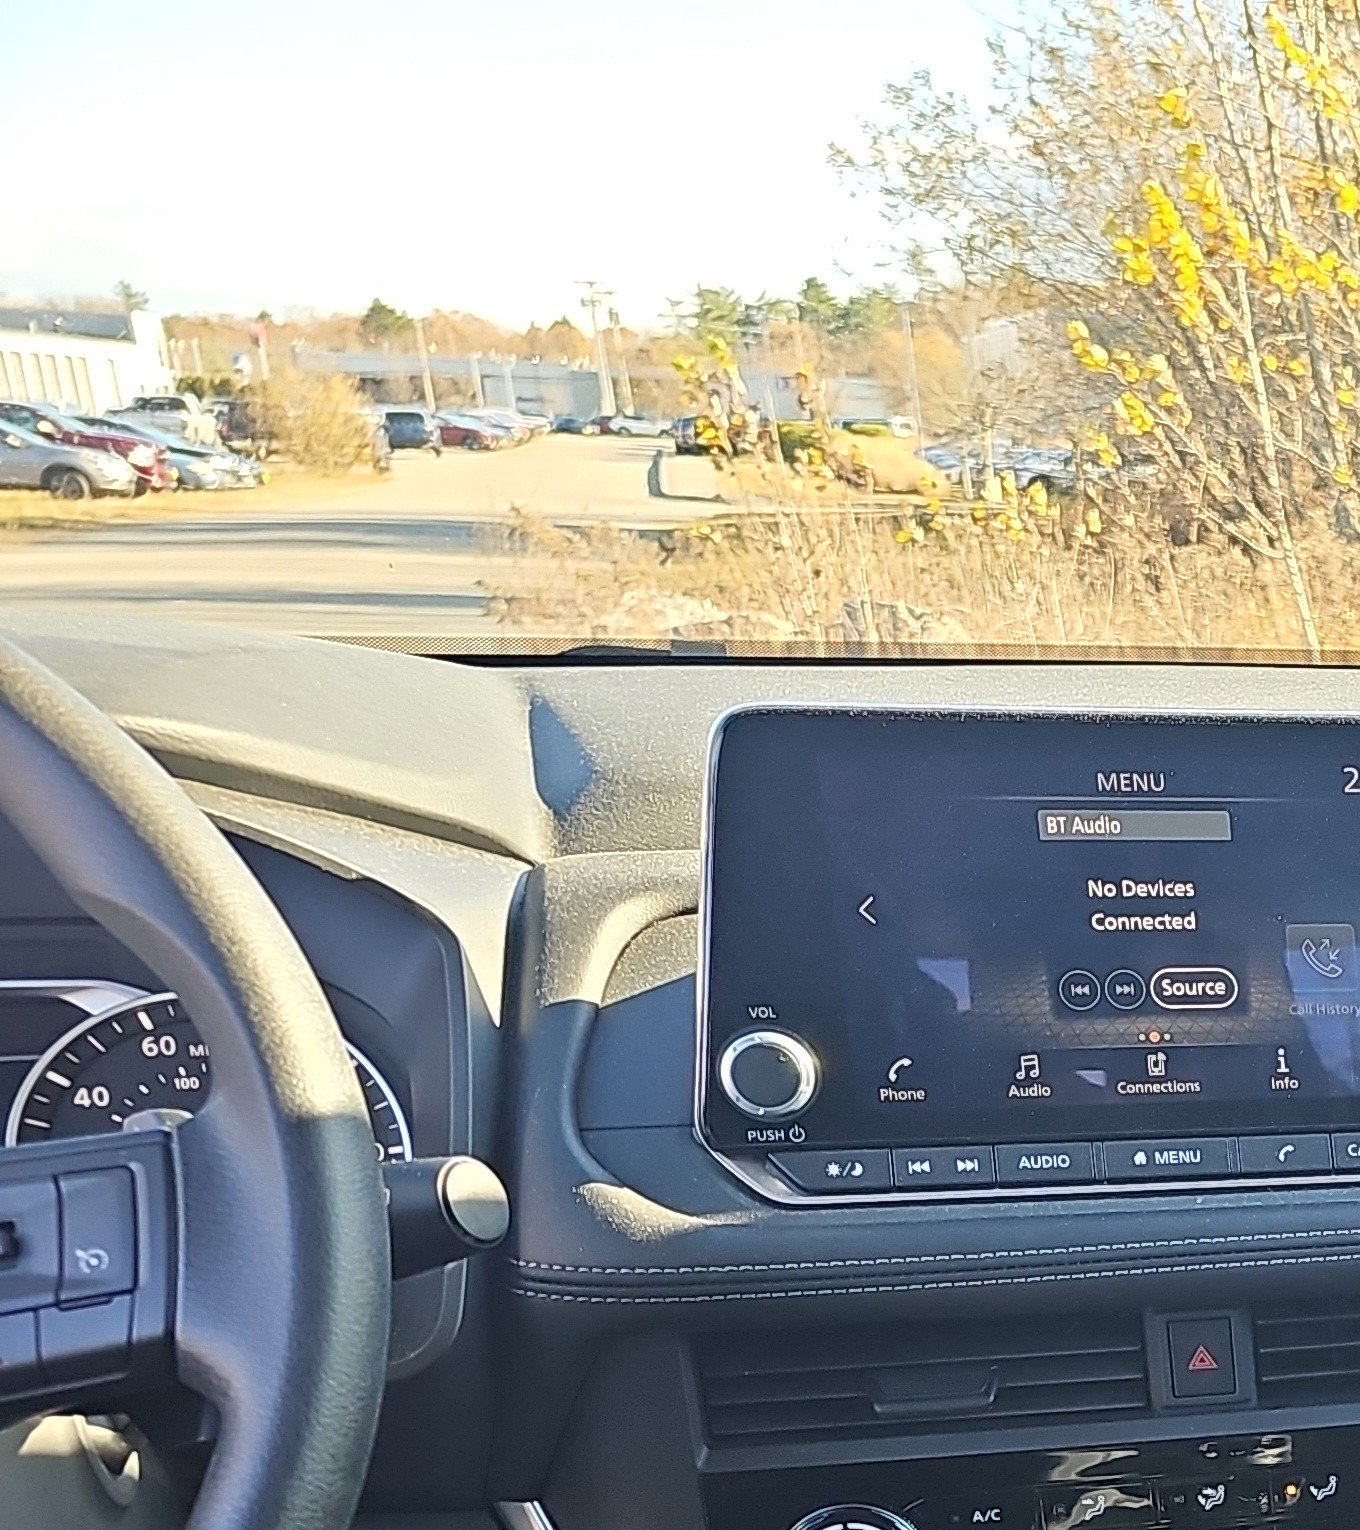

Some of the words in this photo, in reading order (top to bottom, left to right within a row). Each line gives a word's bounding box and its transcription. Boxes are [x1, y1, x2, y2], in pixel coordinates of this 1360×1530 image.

[1097, 773, 1164, 792] MENU
[1046, 817, 1066, 834] BT
[1072, 815, 1121, 835] Audio
[1087, 880, 1116, 898] No
[1121, 879, 1195, 898] Devices
[1091, 913, 1196, 931] Connected
[1161, 978, 1226, 997] Source
[749, 1006, 776, 1019] VOL
[1289, 1002, 1311, 1016] Call
[141, 1036, 177, 1057] 60
[174, 1077, 200, 1090] 100
[1008, 1083, 1051, 1098] Audio
[1117, 1080, 1201, 1094] Connections
[1271, 1076, 1299, 1090] Info
[74, 1085, 110, 1107] 40
[880, 1086, 926, 1102] Phone
[747, 1129, 785, 1143] PUSH
[1018, 1154, 1070, 1170] AUDIO
[1154, 1148, 1201, 1165] MENU
[972, 1507, 1002, 1523] A/C
